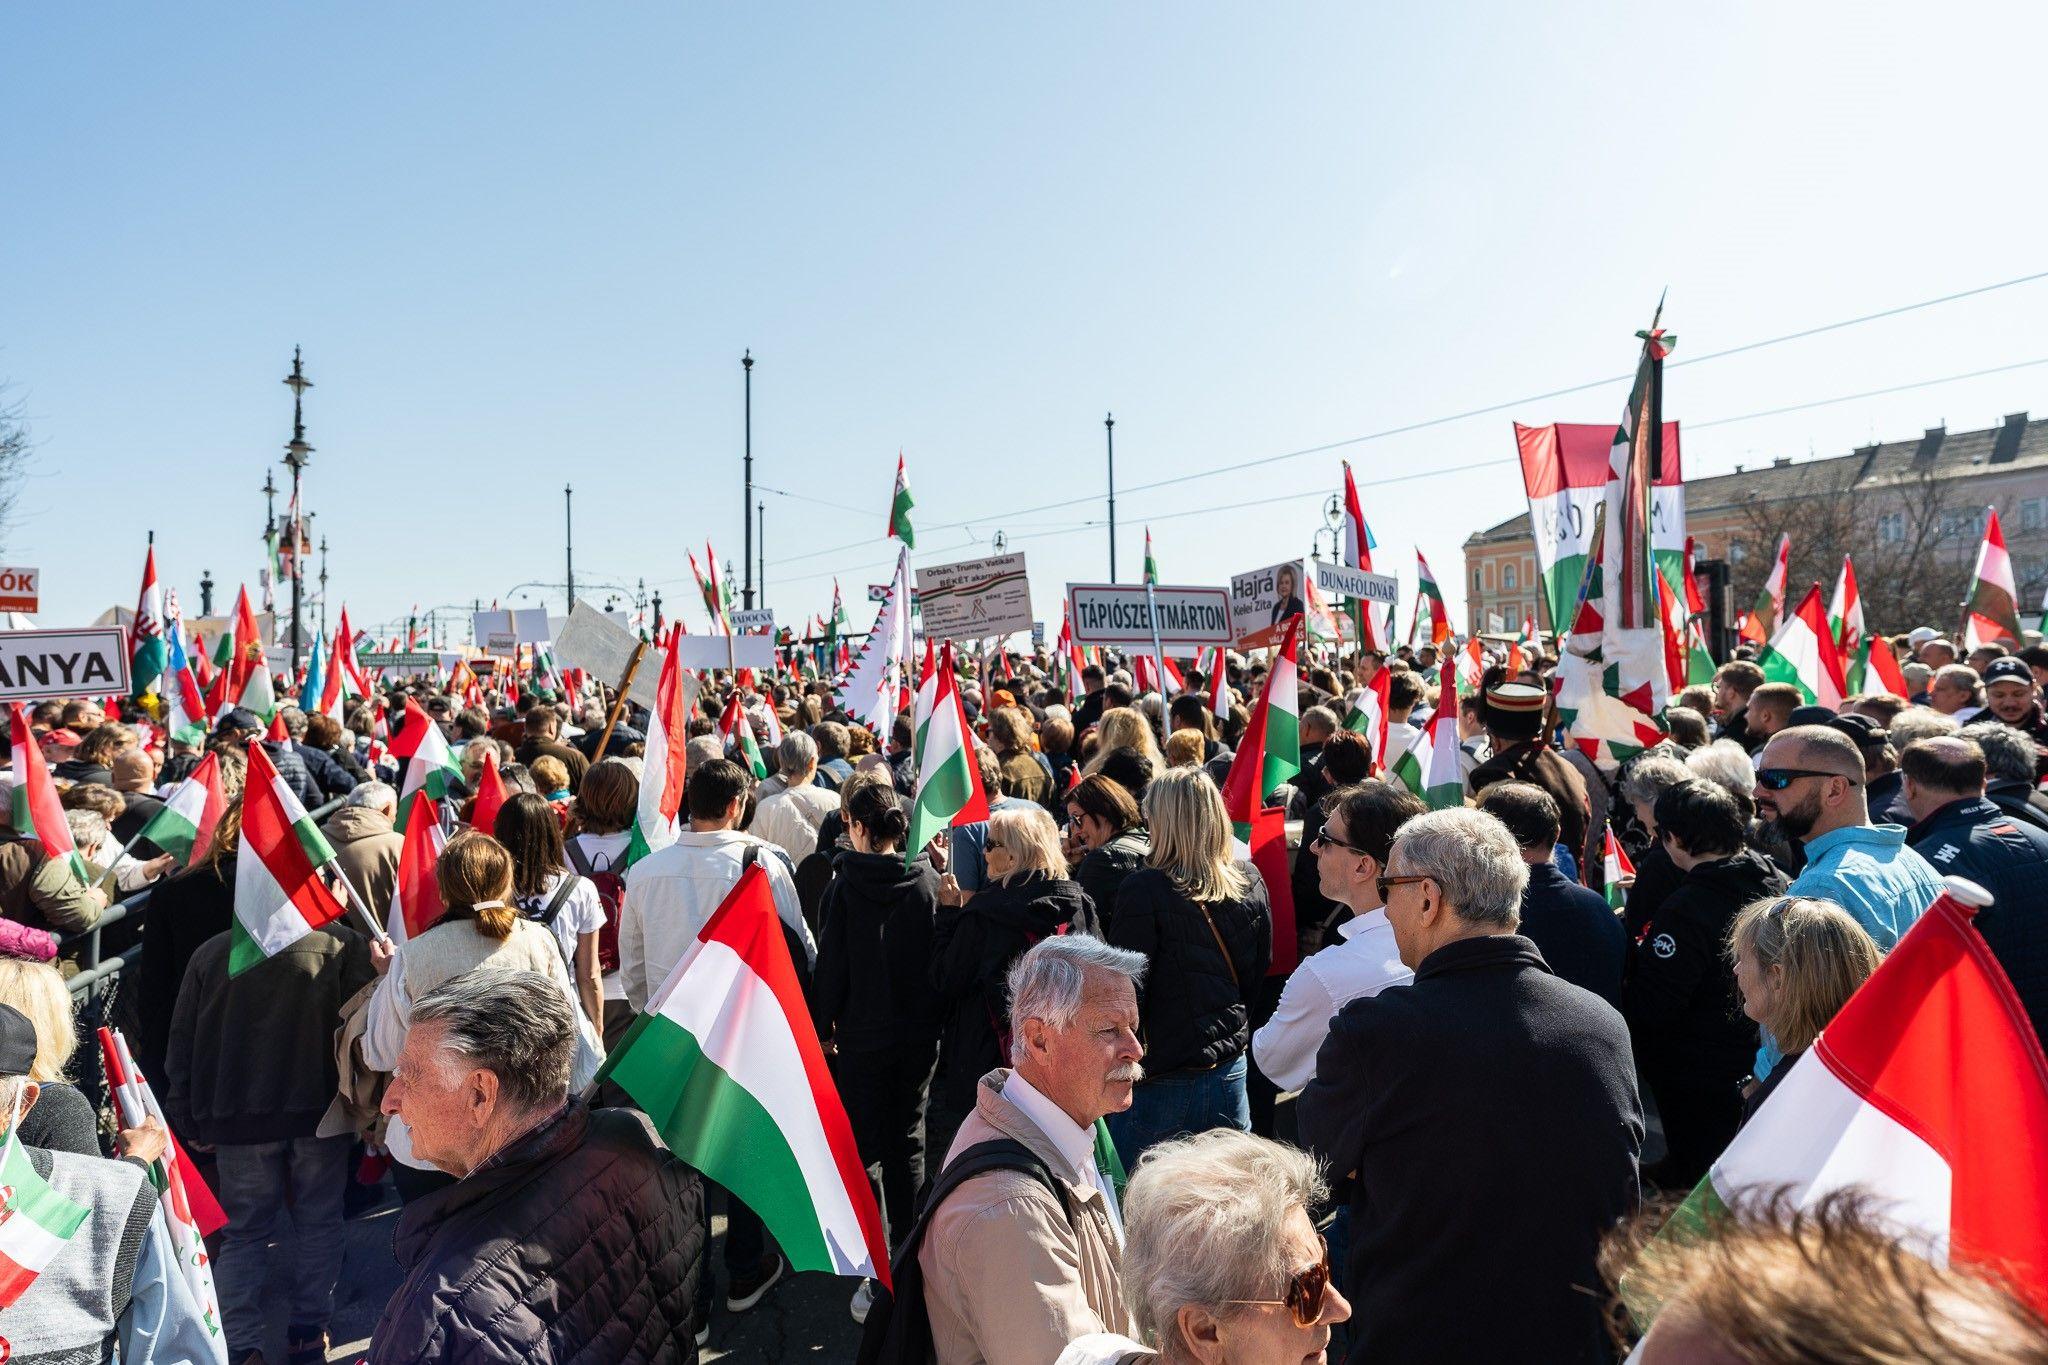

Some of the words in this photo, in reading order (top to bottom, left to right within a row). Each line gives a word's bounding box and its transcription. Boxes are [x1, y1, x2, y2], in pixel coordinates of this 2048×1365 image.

[927, 567, 954, 577] Orbán,
[955, 562, 983, 573] Trump,
[985, 557, 1015, 567] Vatikán
[1233, 571, 1274, 600] Hajrá
[1255, 600, 1272, 610] Zita
[1934, 843, 1961, 864] HH
